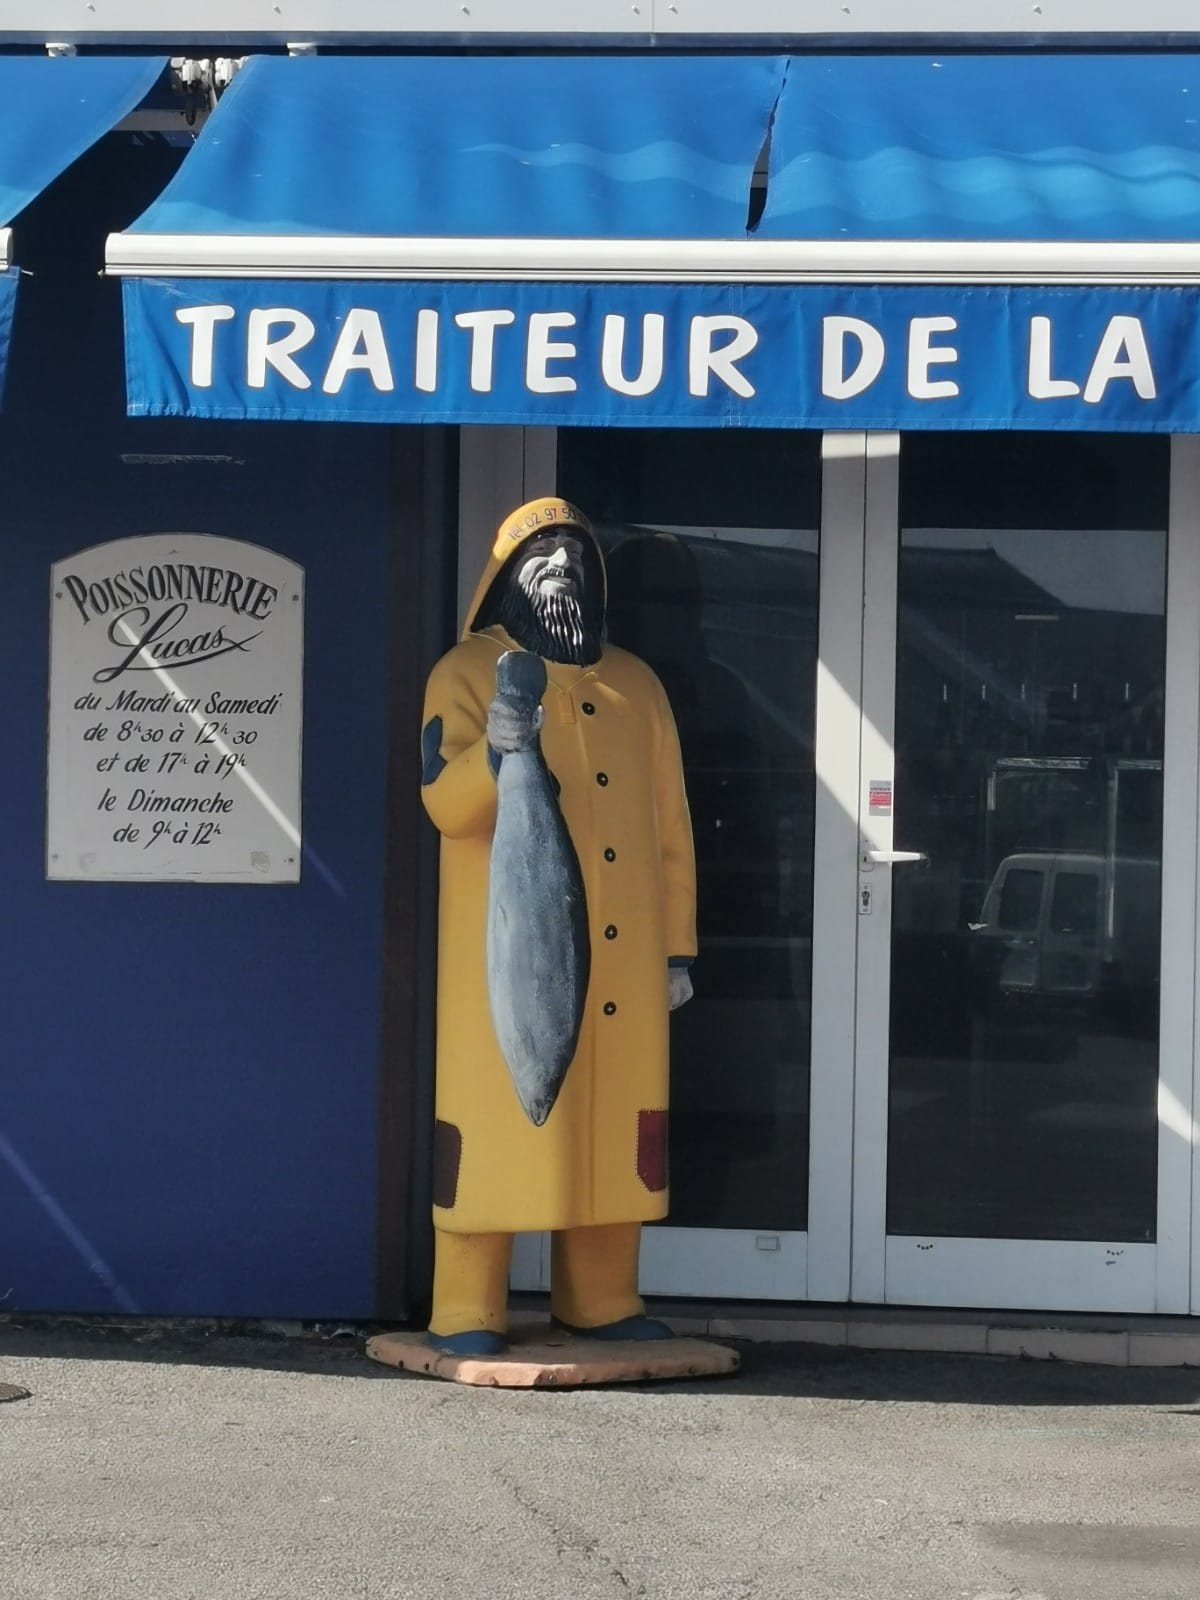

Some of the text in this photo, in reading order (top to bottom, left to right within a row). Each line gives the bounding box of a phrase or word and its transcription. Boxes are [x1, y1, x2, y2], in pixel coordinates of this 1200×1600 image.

[175, 303, 1157, 405] TRAITEUR DE LA
[525, 512, 542, 528] 02
[544, 507, 557, 521] 97
[62, 563, 278, 626] POISSONNERIE
[93, 602, 264, 683] Lucas
[74, 690, 283, 715] du Mardi au Samedi
[83, 723, 108, 743] de
[169, 722, 185, 744] à
[96, 754, 120, 773] et
[124, 753, 150, 774] de
[194, 753, 210, 774] à
[97, 788, 233, 813] le Dimanche
[113, 822, 139, 842] de
[173, 826, 188, 844] à
